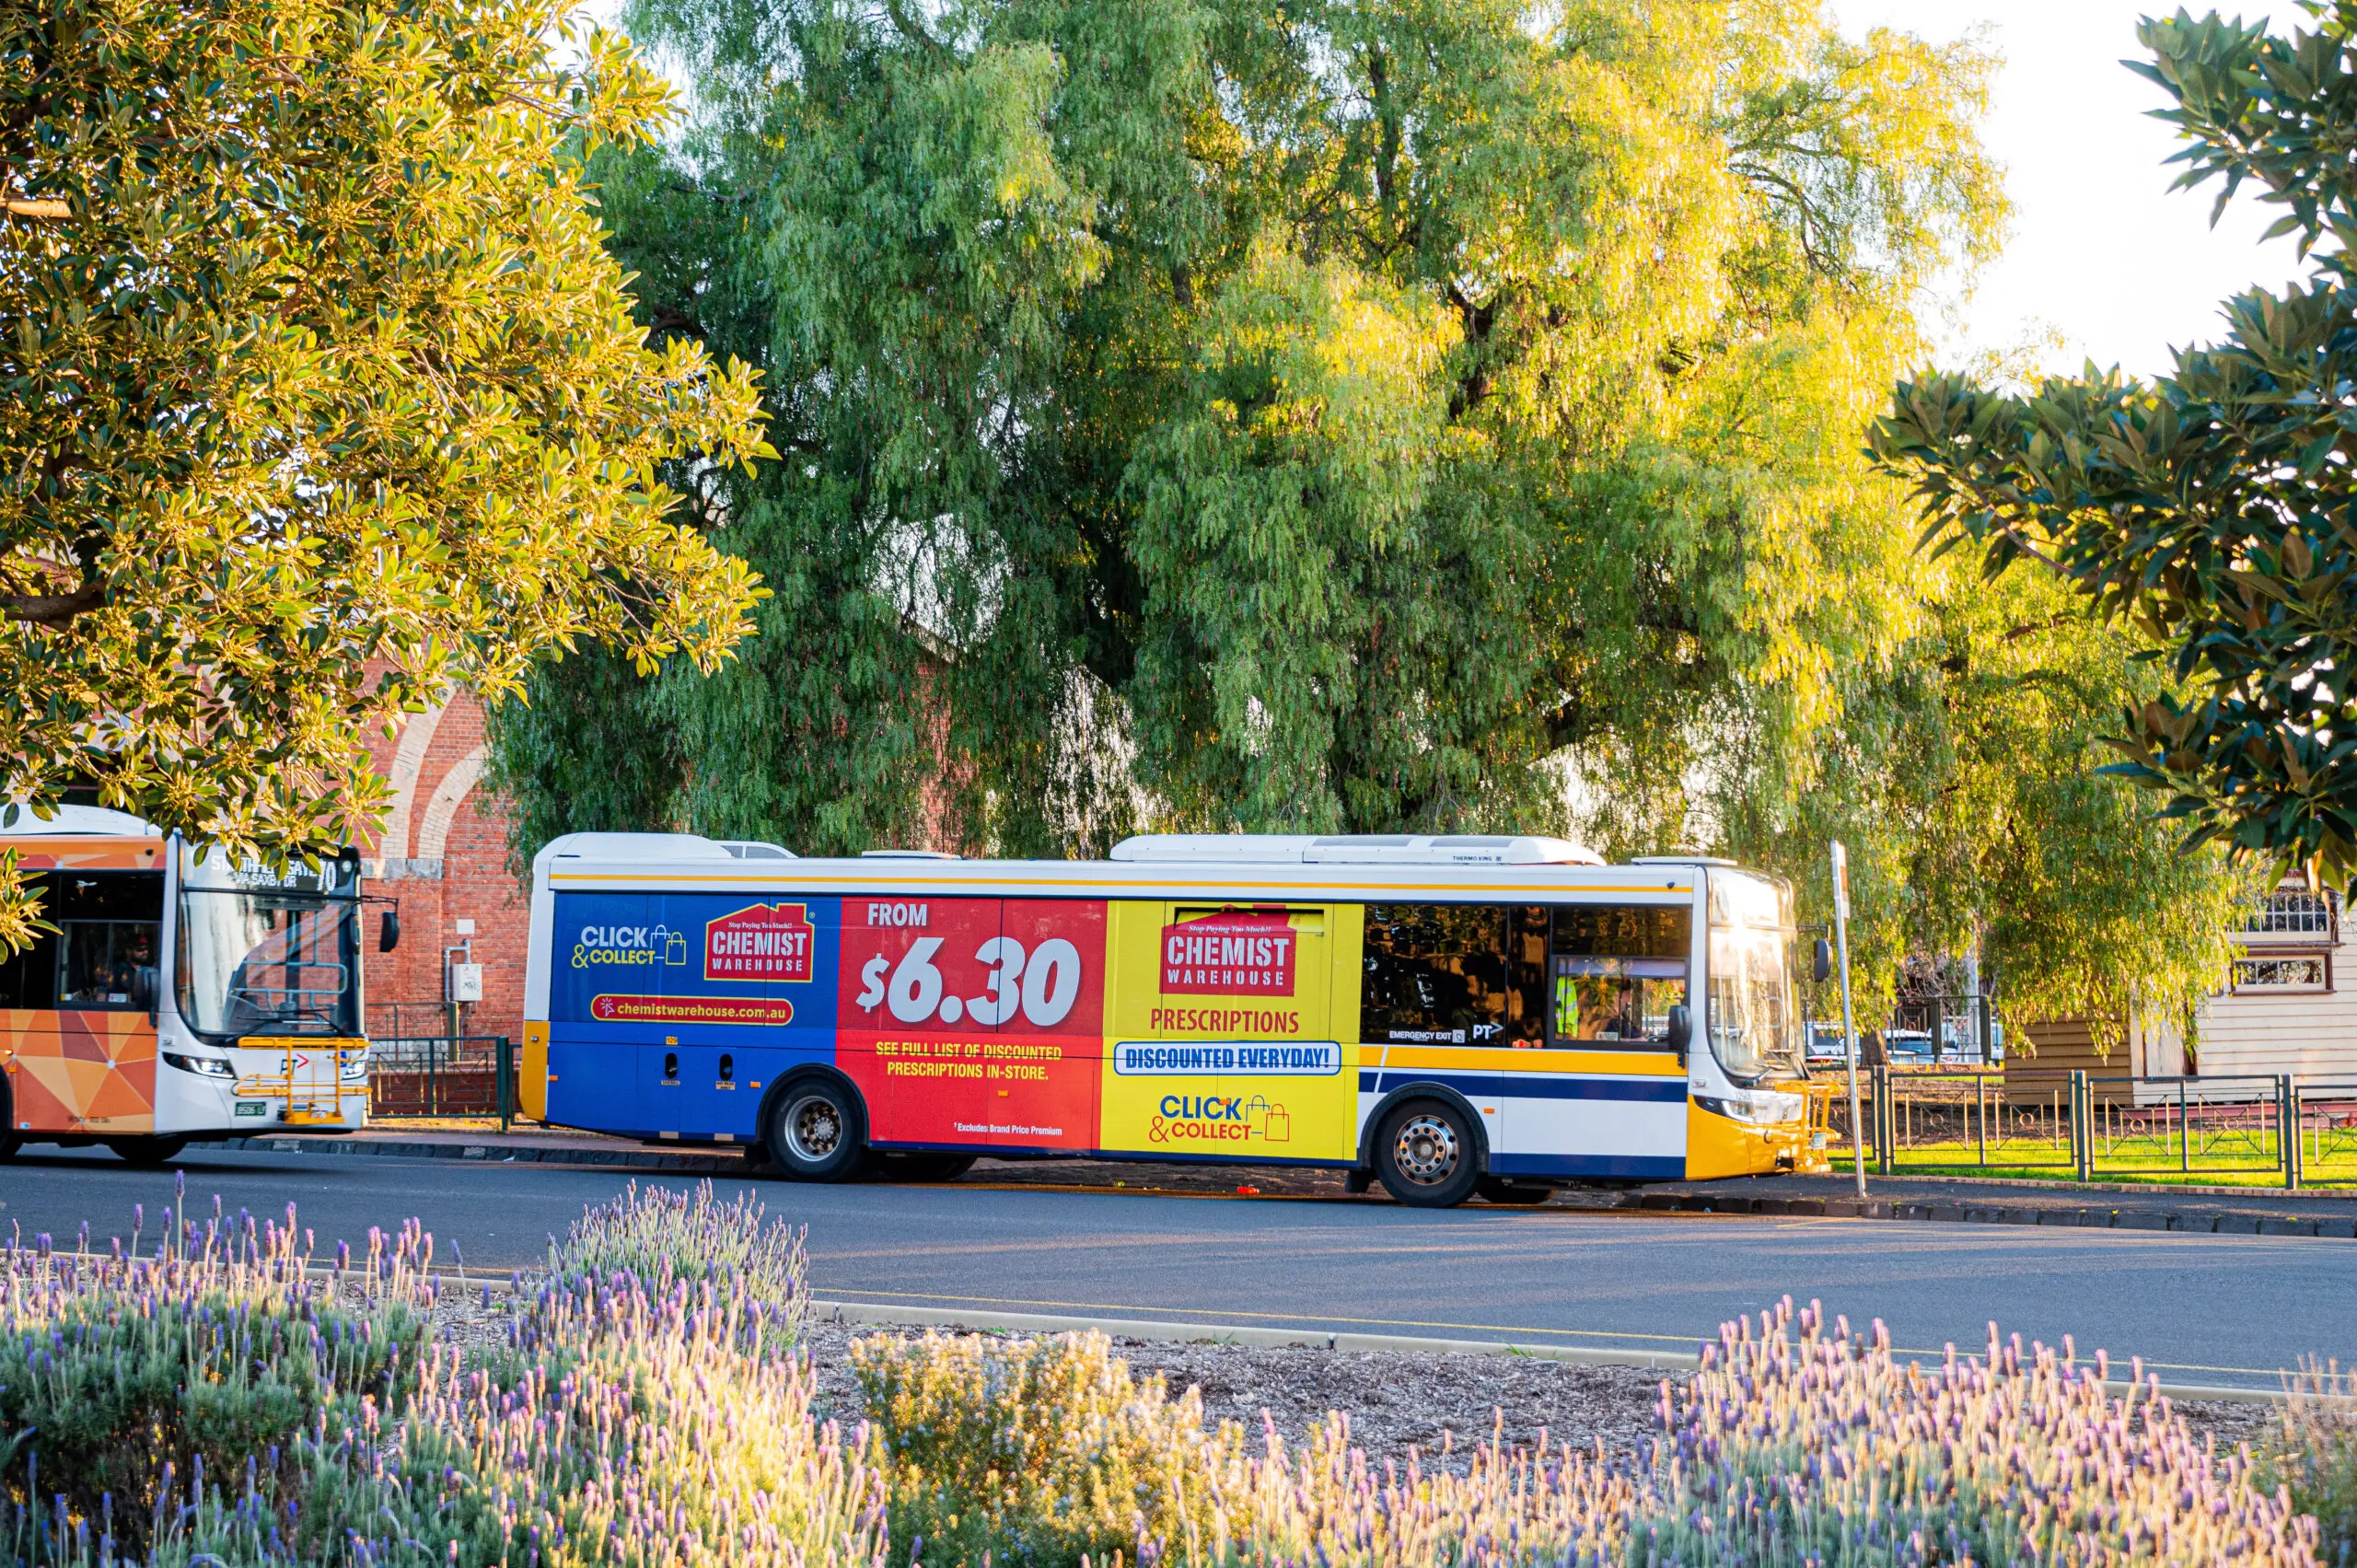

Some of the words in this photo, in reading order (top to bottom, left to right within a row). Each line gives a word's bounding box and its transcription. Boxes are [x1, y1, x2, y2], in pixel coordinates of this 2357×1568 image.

[867, 903, 928, 927] FROM
[741, 922, 761, 930] Paying
[1188, 924, 1205, 933] Stop
[1206, 924, 1230, 934] Paying
[581, 925, 649, 948] CLICK
[713, 931, 807, 957] CHEMIST
[1167, 935, 1290, 967] CHEMIST
[712, 958, 803, 972] WAREHOUSE
[855, 935, 1081, 1027] $6.30
[1167, 969, 1284, 986] WAREHOUSE
[618, 1002, 786, 1019] chemistwarehouse.com.au
[1150, 1008, 1300, 1034] PRESCRIPTIONS
[1389, 1030, 1435, 1040] EMERGENCY
[1435, 1031, 1452, 1040] EXIT
[876, 1041, 899, 1056] SEE
[901, 1042, 932, 1057] FULL
[935, 1043, 961, 1058] LIST
[964, 1043, 981, 1058] OF
[983, 1044, 1062, 1061] DISCOUNTED
[1125, 1048, 1235, 1069] DISCOUNTED
[1237, 1048, 1330, 1069] EVERYDAY!
[887, 1062, 983, 1078] PRESCRIPTIONS
[986, 1064, 1050, 1081] IN-STORE.
[1159, 1095, 1243, 1121] CLICK
[989, 1124, 1010, 1134] Brand
[1011, 1125, 1029, 1135] Price
[1030, 1126, 1062, 1136] Premium
